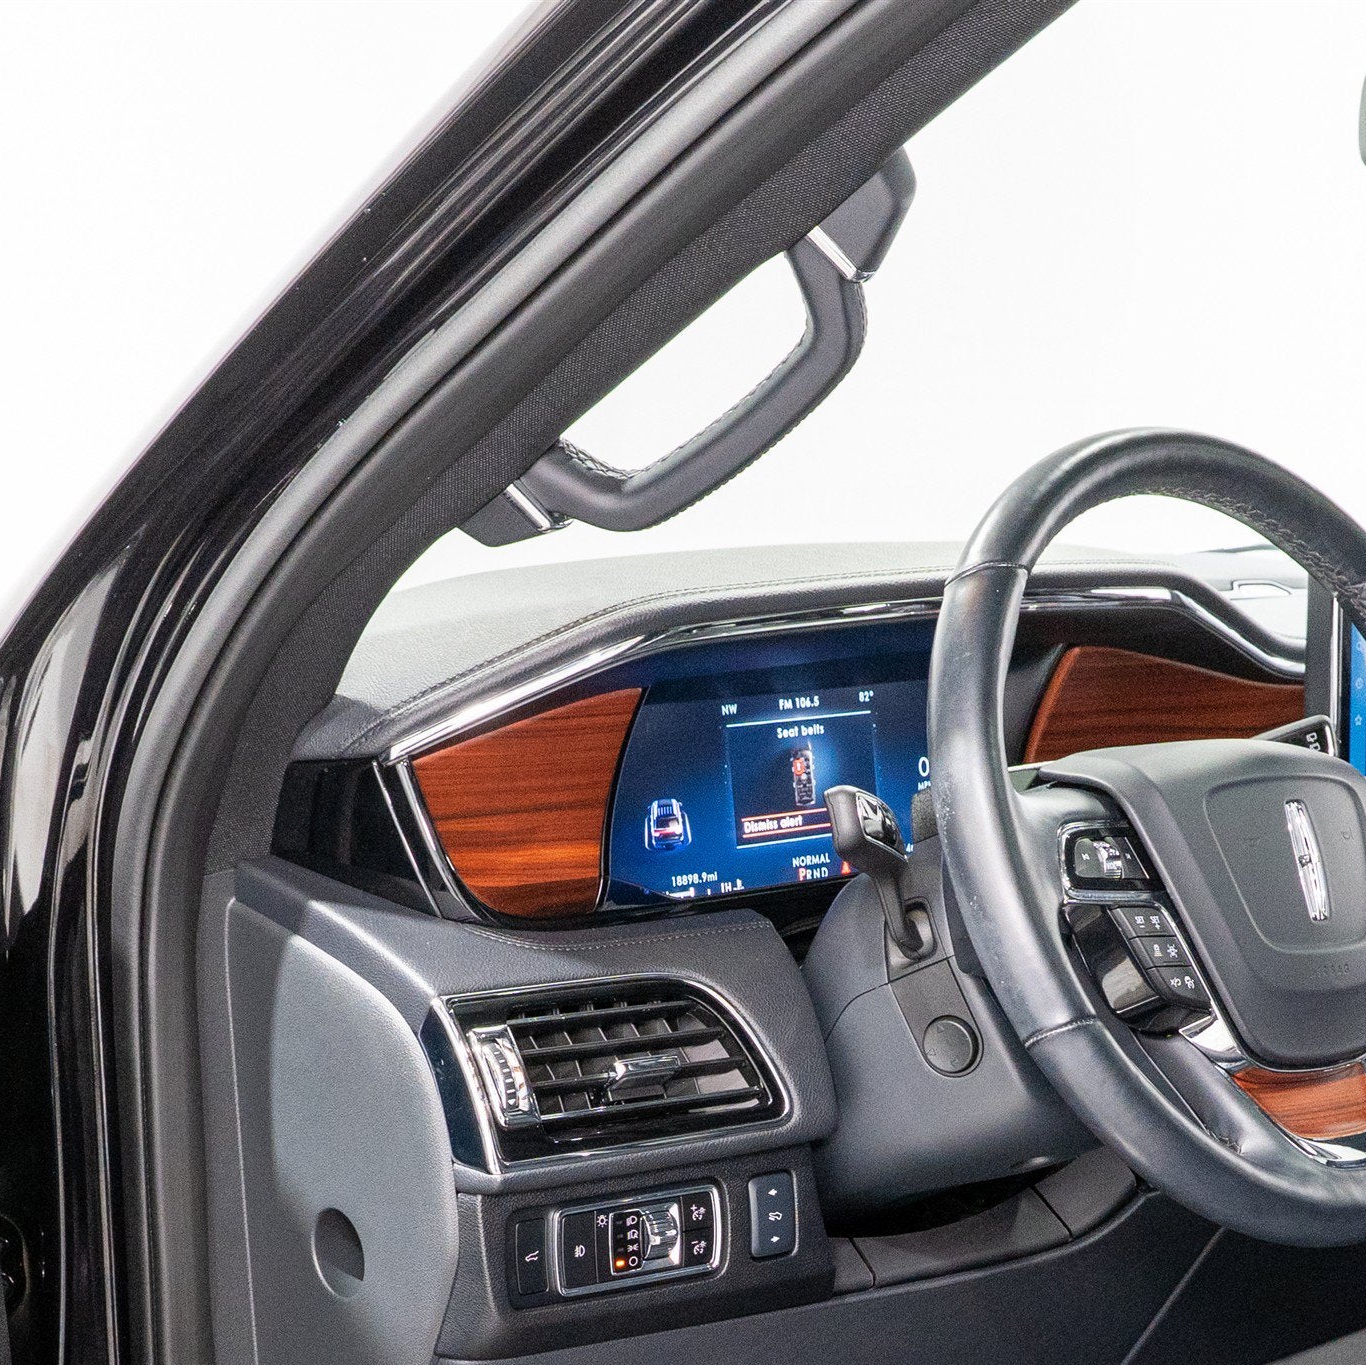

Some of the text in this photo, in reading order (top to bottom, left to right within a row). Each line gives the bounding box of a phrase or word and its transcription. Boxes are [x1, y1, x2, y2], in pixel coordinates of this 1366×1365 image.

[721, 704, 738, 716] NW
[778, 695, 819, 710] FM 106.5
[776, 724, 825, 739] Seat belts
[918, 756, 930, 777] 0
[743, 815, 803, 833] Dismiss alert
[792, 853, 831, 867] NORMAL
